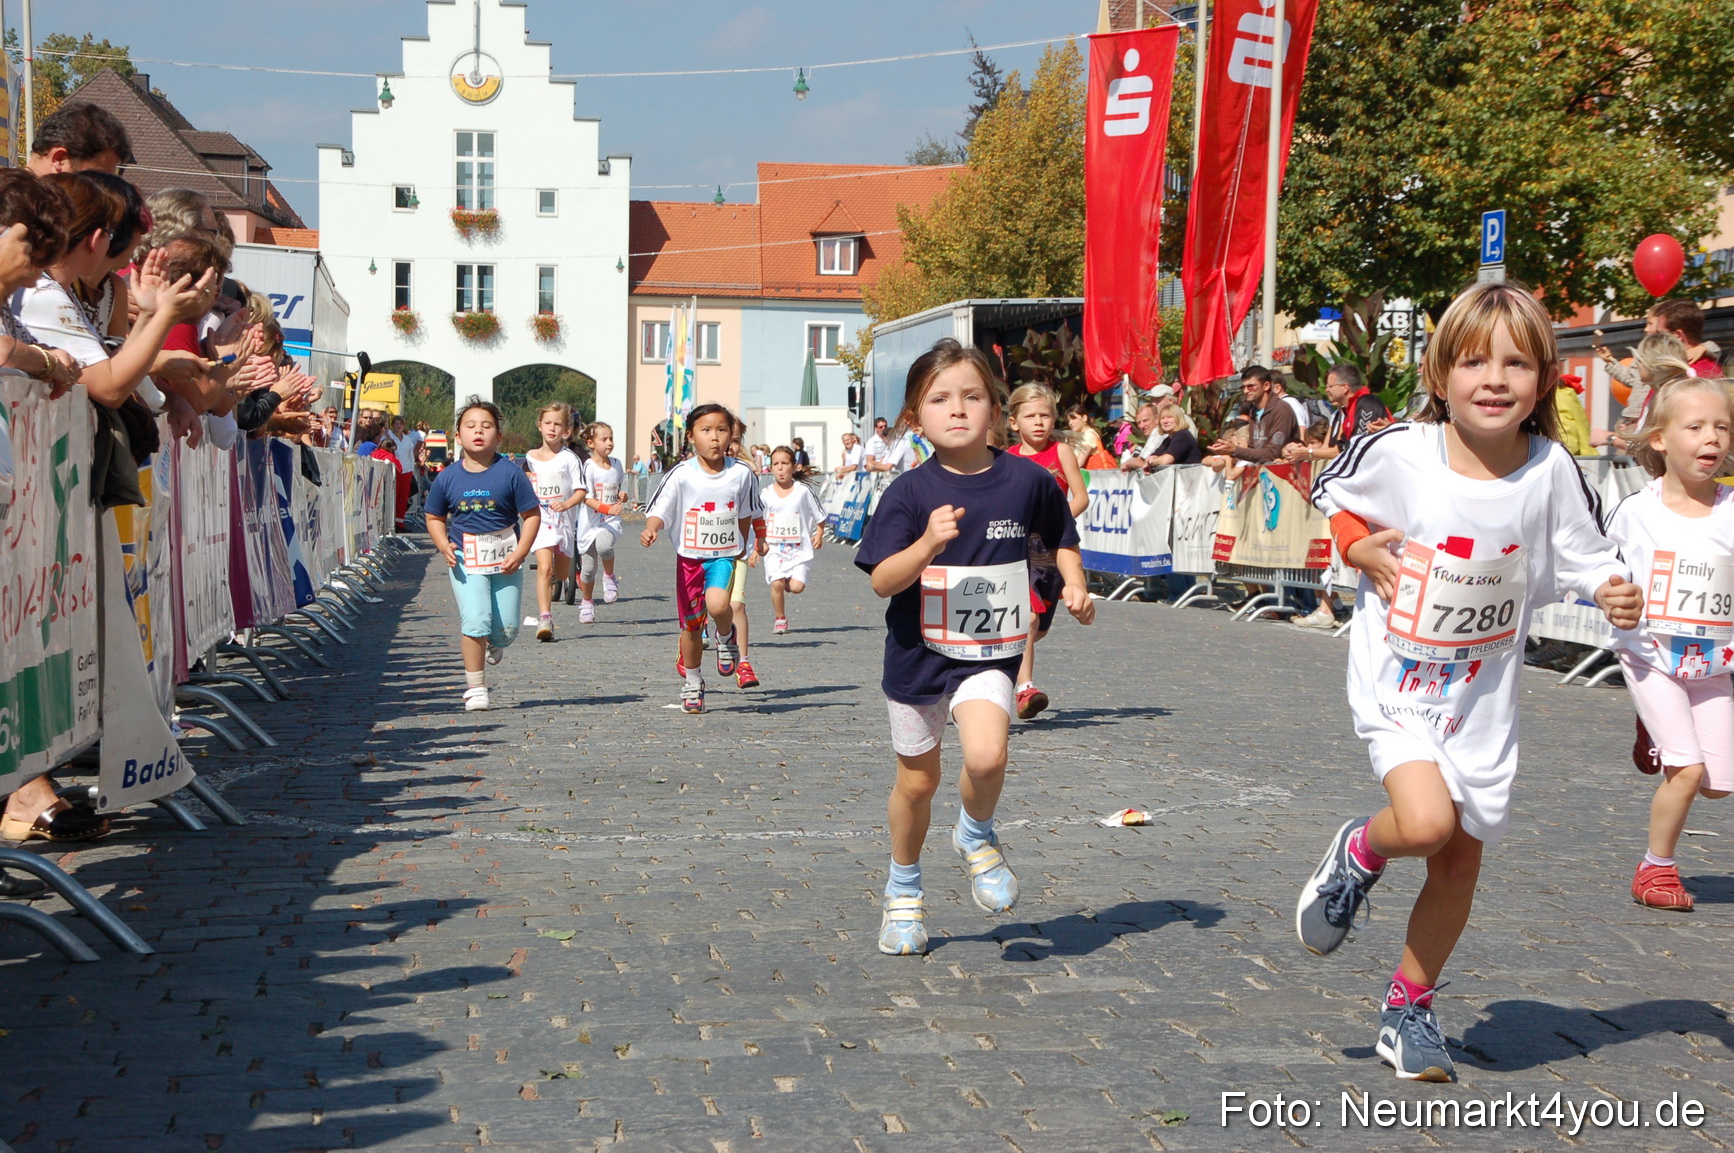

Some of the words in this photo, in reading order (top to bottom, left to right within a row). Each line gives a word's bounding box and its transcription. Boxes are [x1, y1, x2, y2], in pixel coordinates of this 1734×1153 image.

[1486, 218, 1500, 257] P
[363, 380, 395, 394] Glossner
[463, 489, 490, 497] adidas
[700, 517, 714, 526] Dac
[716, 517, 735, 526] Tuong
[989, 518, 1012, 528] sport
[701, 531, 735, 544] 7064
[775, 527, 798, 535] 7215
[1678, 559, 1715, 580] Emily
[963, 581, 1007, 596] LENA
[1678, 589, 1732, 616] 7139
[955, 604, 1020, 634] 7271
[1432, 599, 1515, 634] 7280
[1388, 634, 1437, 656] BOCK
[1470, 636, 1514, 654] PFLEIDERER
[1444, 714, 1464, 735] TV
